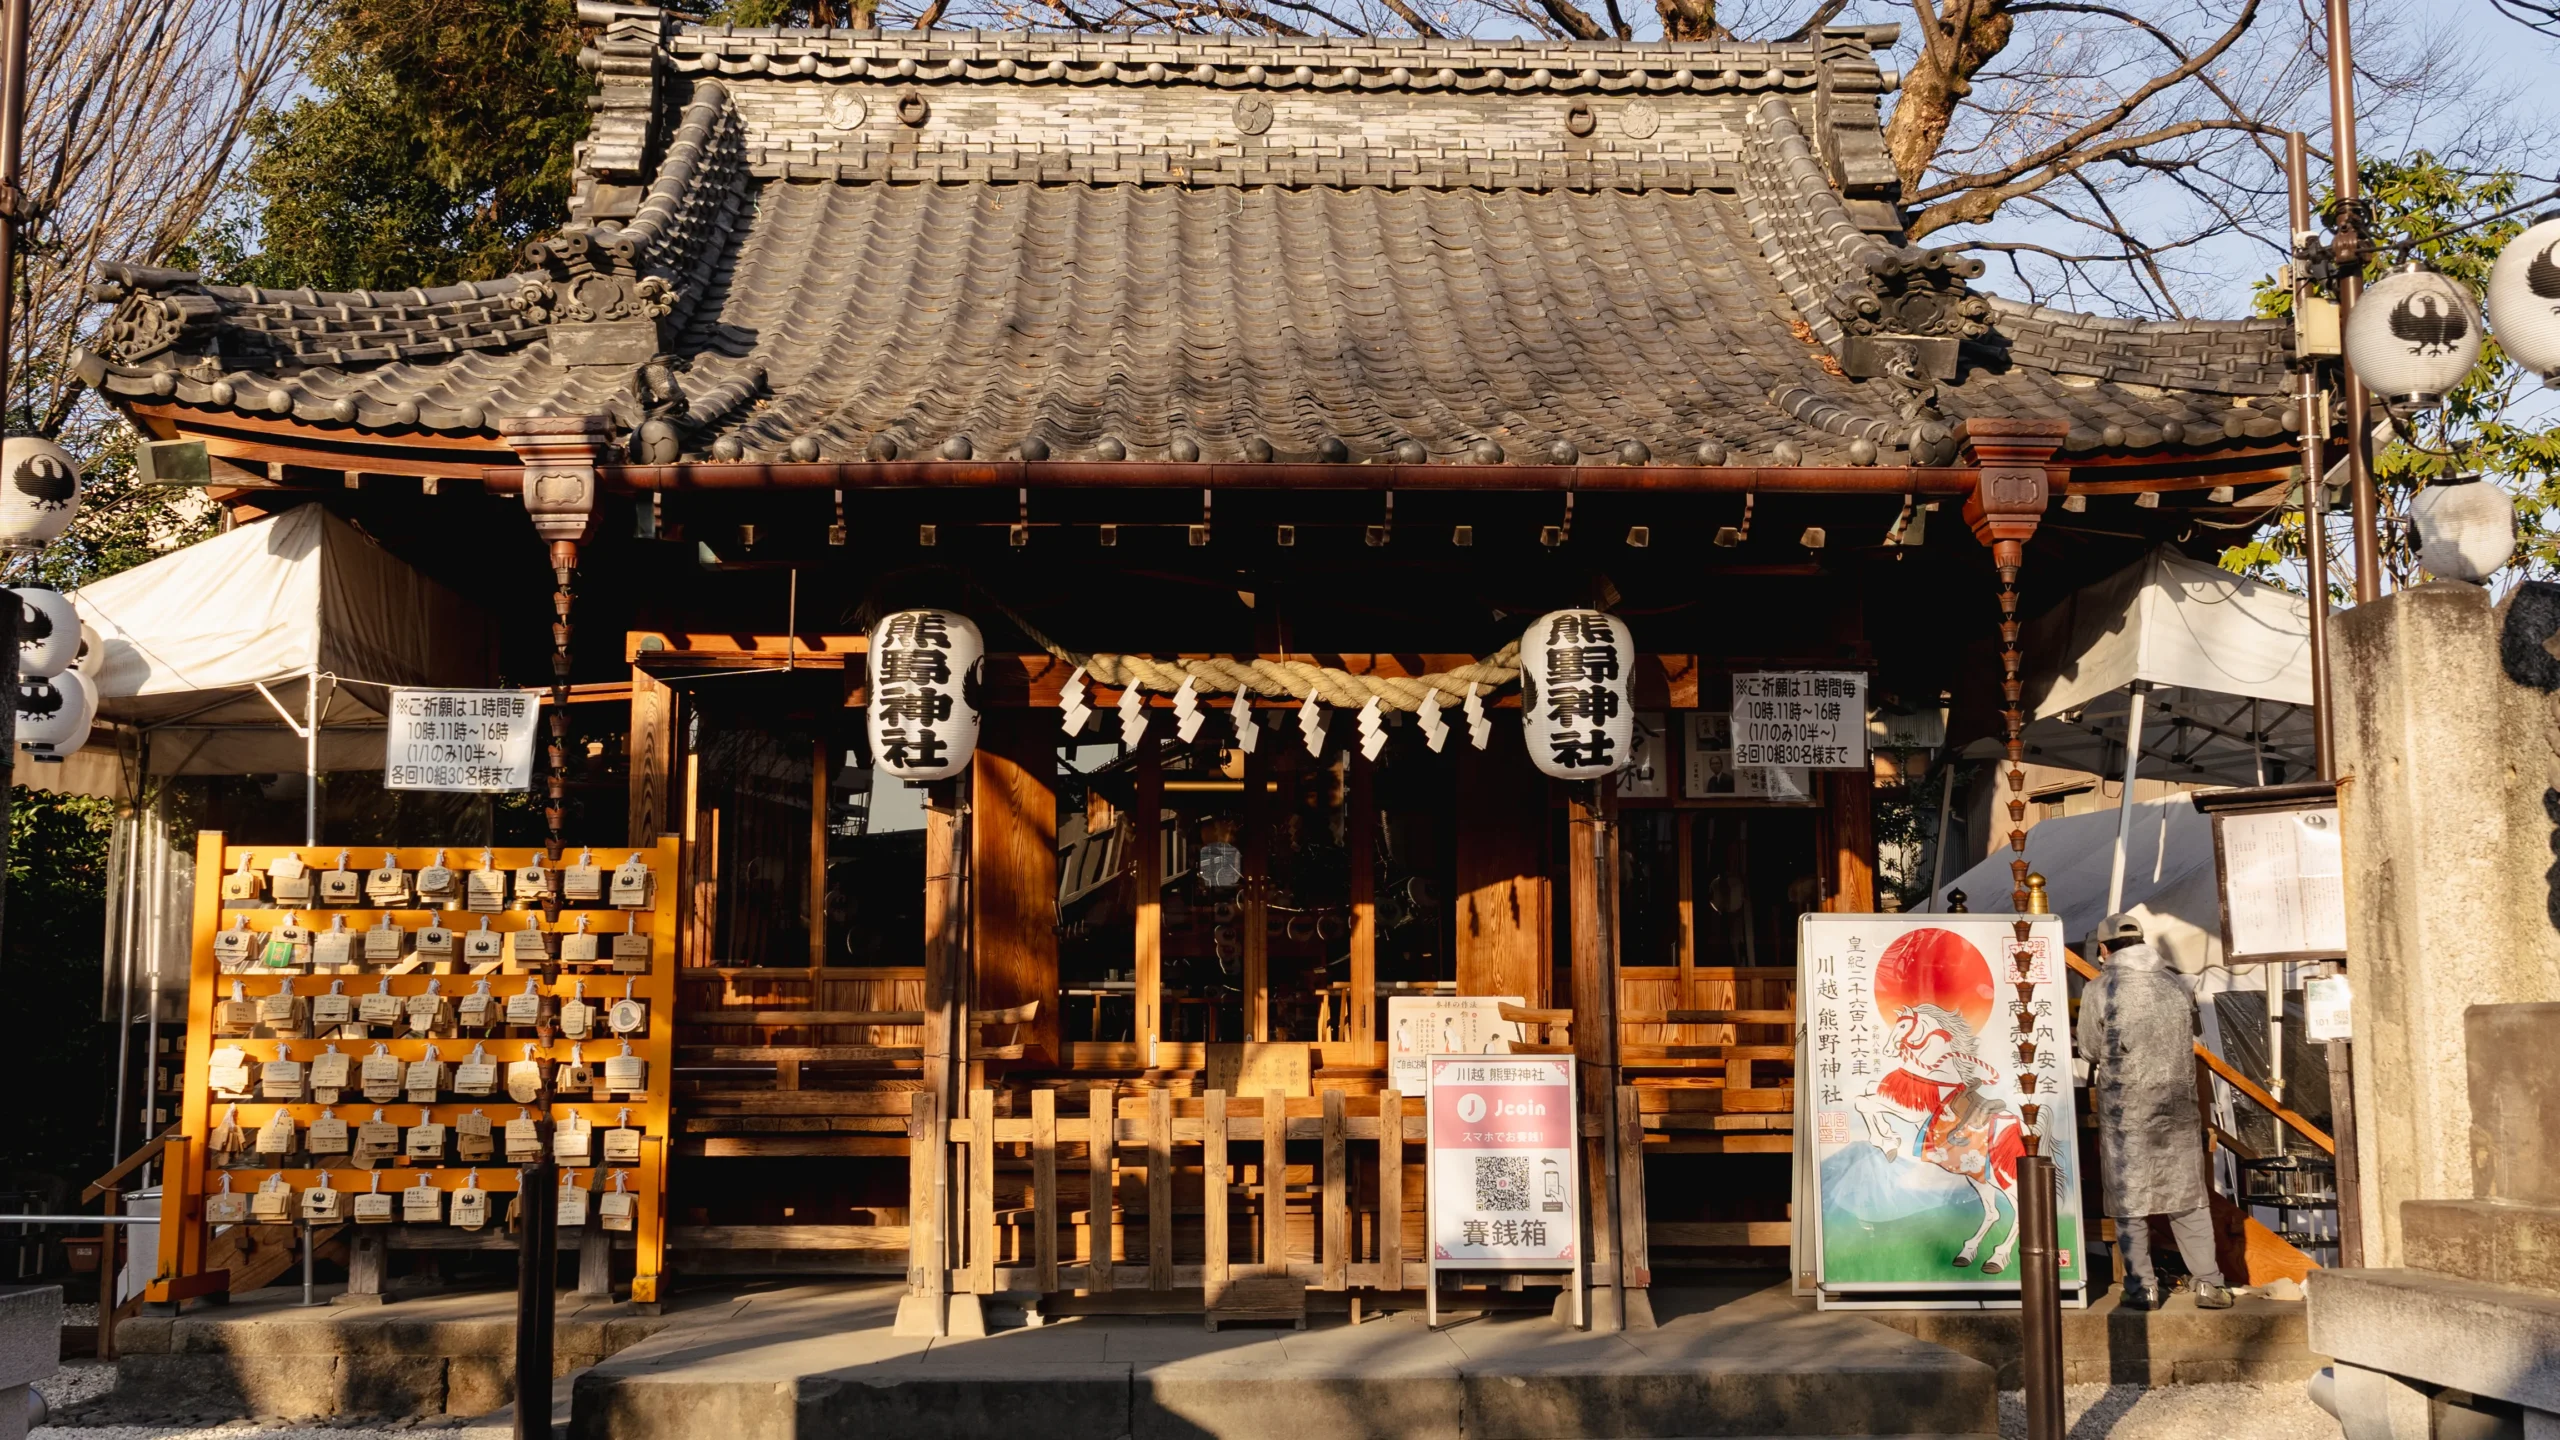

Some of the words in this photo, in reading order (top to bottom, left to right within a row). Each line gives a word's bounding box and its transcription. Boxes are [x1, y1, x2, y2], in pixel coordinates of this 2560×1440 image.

[879, 612, 954, 769] 熊野神社
[1546, 614, 1619, 768] 熊野神社
[1736, 744, 1848, 764] 各回10組30名様まで
[391, 765, 516, 786] 各回10組30名様まで
[1816, 955, 1839, 1000] 川越
[1817, 1007, 1843, 1105] 熊野神社
[2034, 998, 2059, 1095] 家内安全
[1457, 1067, 1485, 1082] 川越
[1489, 1067, 1546, 1082] 熊野神社
[1494, 1098, 1546, 1117] Jcoin
[1462, 1218, 1547, 1248] 賽銭箱
